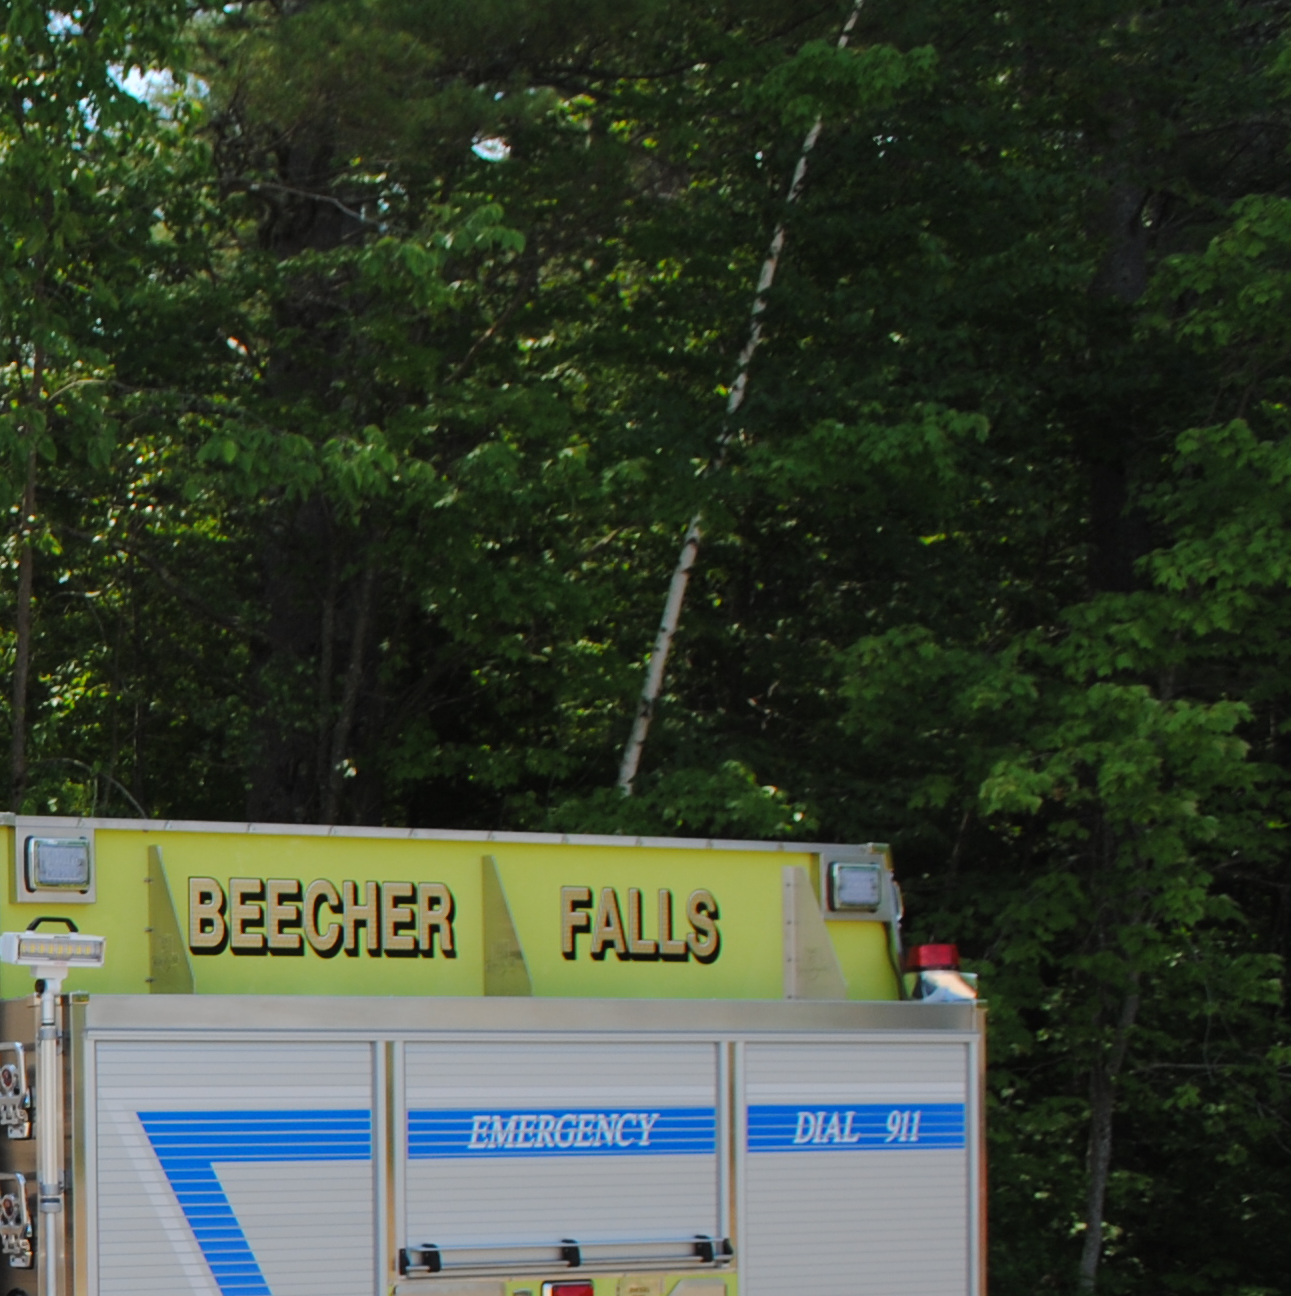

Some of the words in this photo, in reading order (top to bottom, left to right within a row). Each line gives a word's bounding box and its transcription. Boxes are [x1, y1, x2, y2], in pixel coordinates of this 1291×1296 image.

[187, 875, 457, 959] BEECHER
[560, 885, 721, 964] FALLS
[467, 1112, 661, 1150] EMERGENCY
[793, 1109, 861, 1146] DIAL
[885, 1110, 922, 1143] 911
